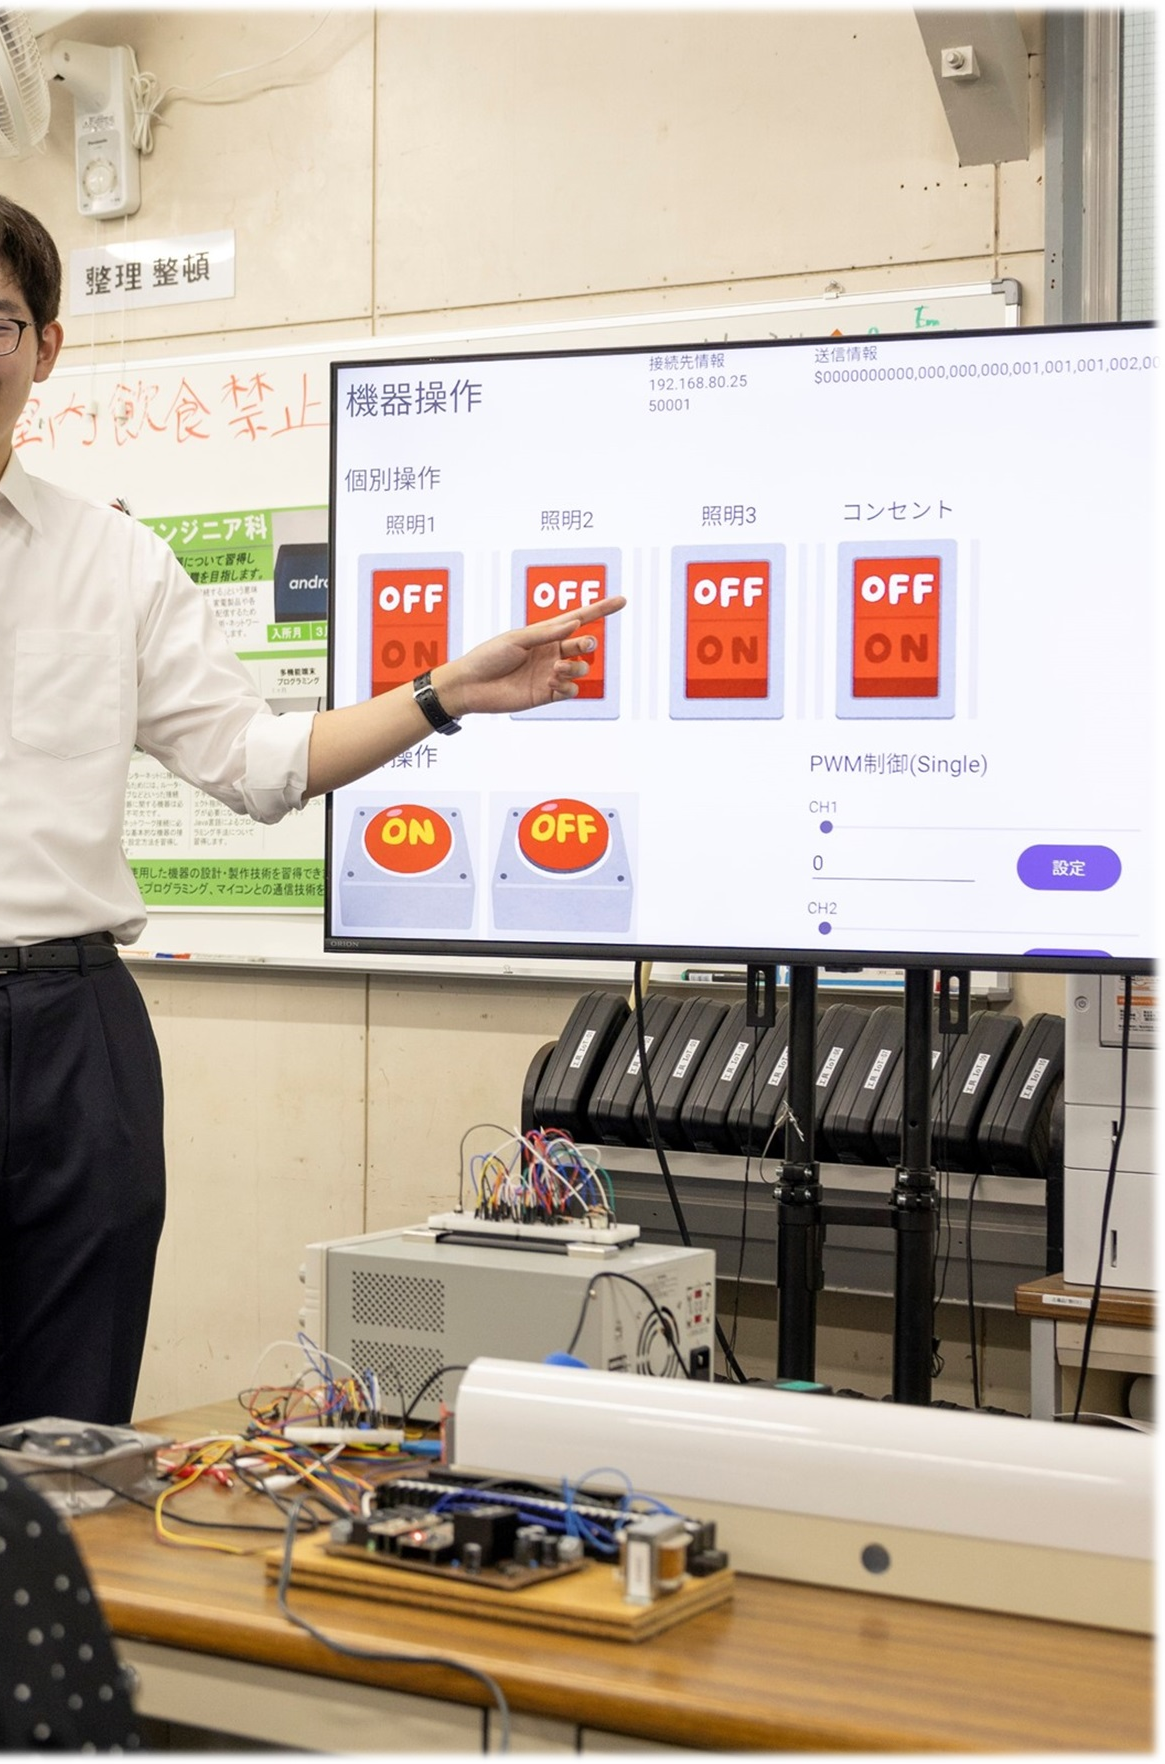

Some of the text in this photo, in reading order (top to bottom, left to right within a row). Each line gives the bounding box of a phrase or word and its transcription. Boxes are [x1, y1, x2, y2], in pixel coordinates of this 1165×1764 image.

[85, 251, 211, 296] 整理 整頓
[648, 353, 726, 372] 接続先情報
[815, 345, 878, 364] 送信情報
[649, 373, 749, 392] 192.168.80.25
[345, 378, 484, 417] 機器操作
[648, 398, 691, 413] 50001
[344, 465, 442, 493] 個別操作
[541, 510, 595, 531] 照明2
[701, 505, 757, 526] 照明3
[843, 500, 953, 521] コンセント
[149, 513, 268, 545] ンジニア科
[386, 514, 435, 535] 照明1
[379, 583, 444, 614] OFF
[533, 580, 601, 611] OFF
[693, 576, 764, 608] OFF
[861, 573, 935, 605] OFF
[382, 639, 439, 669] ON
[696, 635, 758, 665] ON
[864, 633, 929, 664] ON
[810, 753, 989, 778] PWM制御(Single)
[809, 800, 838, 814] CH1
[381, 817, 435, 845] ON
[530, 813, 598, 844] OFF
[812, 854, 824, 871] 0
[1052, 860, 1087, 878] 設定
[807, 901, 838, 915] CH2
